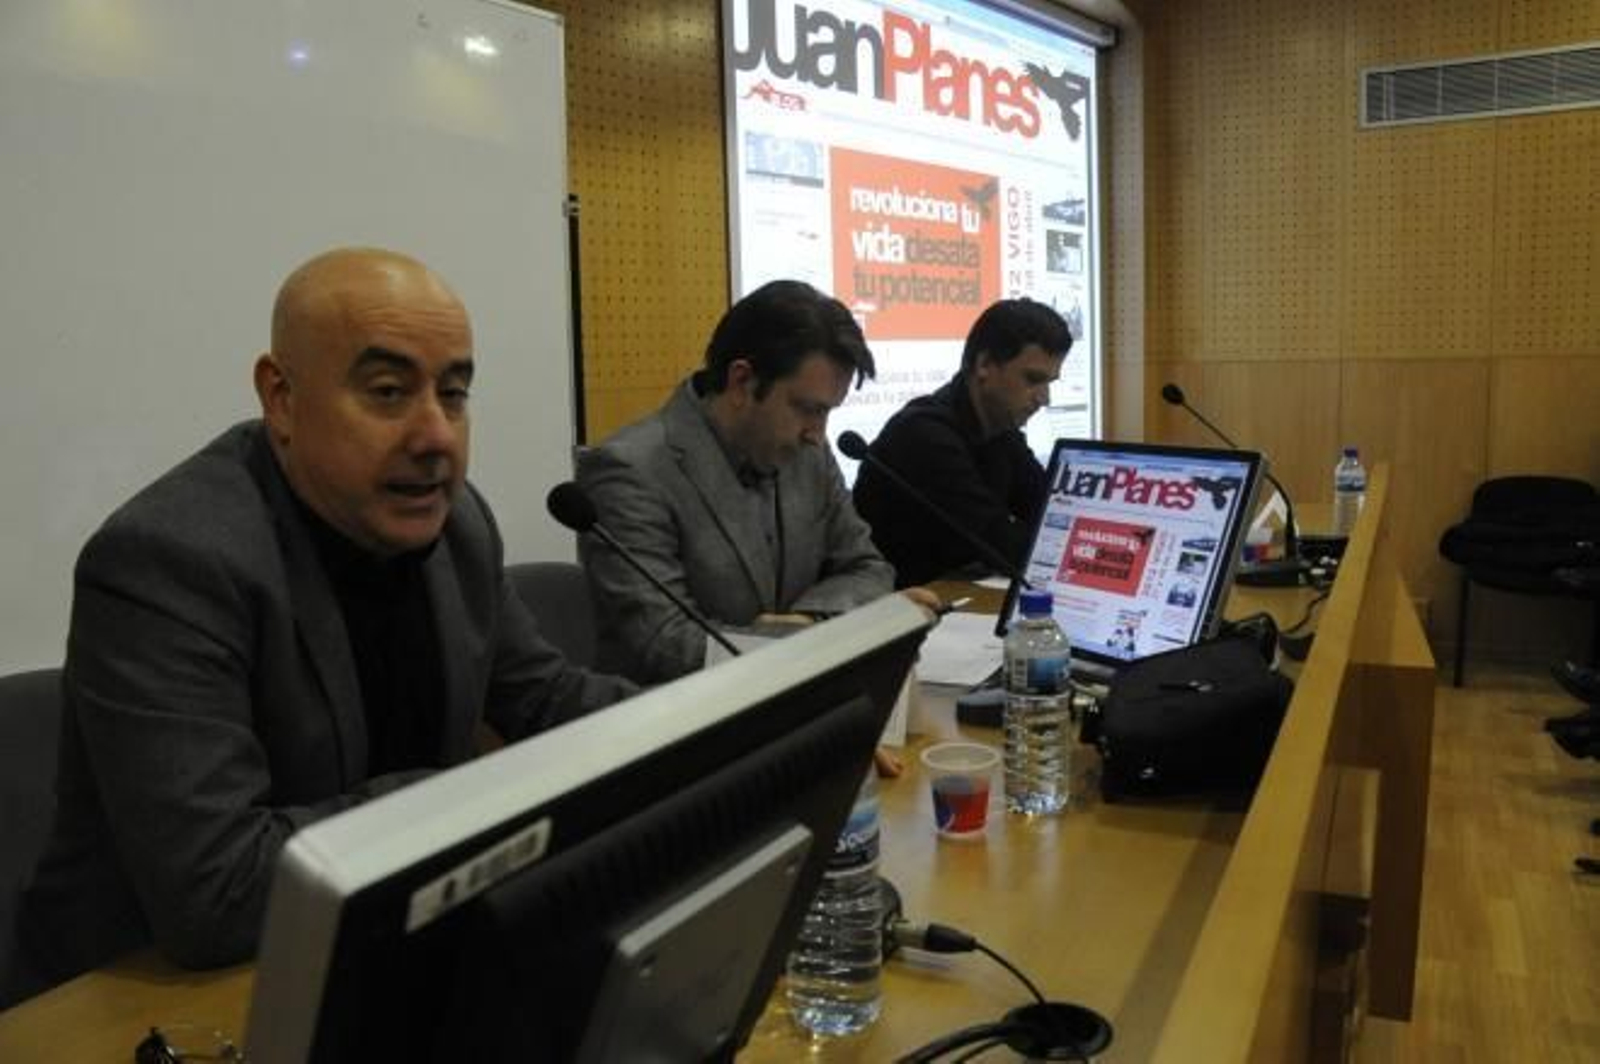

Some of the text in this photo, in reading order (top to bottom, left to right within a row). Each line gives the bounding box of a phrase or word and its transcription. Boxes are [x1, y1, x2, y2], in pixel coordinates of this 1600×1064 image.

[851, 186, 981, 232] revoluciona tu
[1007, 186, 1021, 259] VIGO
[852, 222, 981, 269] vida desata
[853, 266, 981, 310] tu potencial
